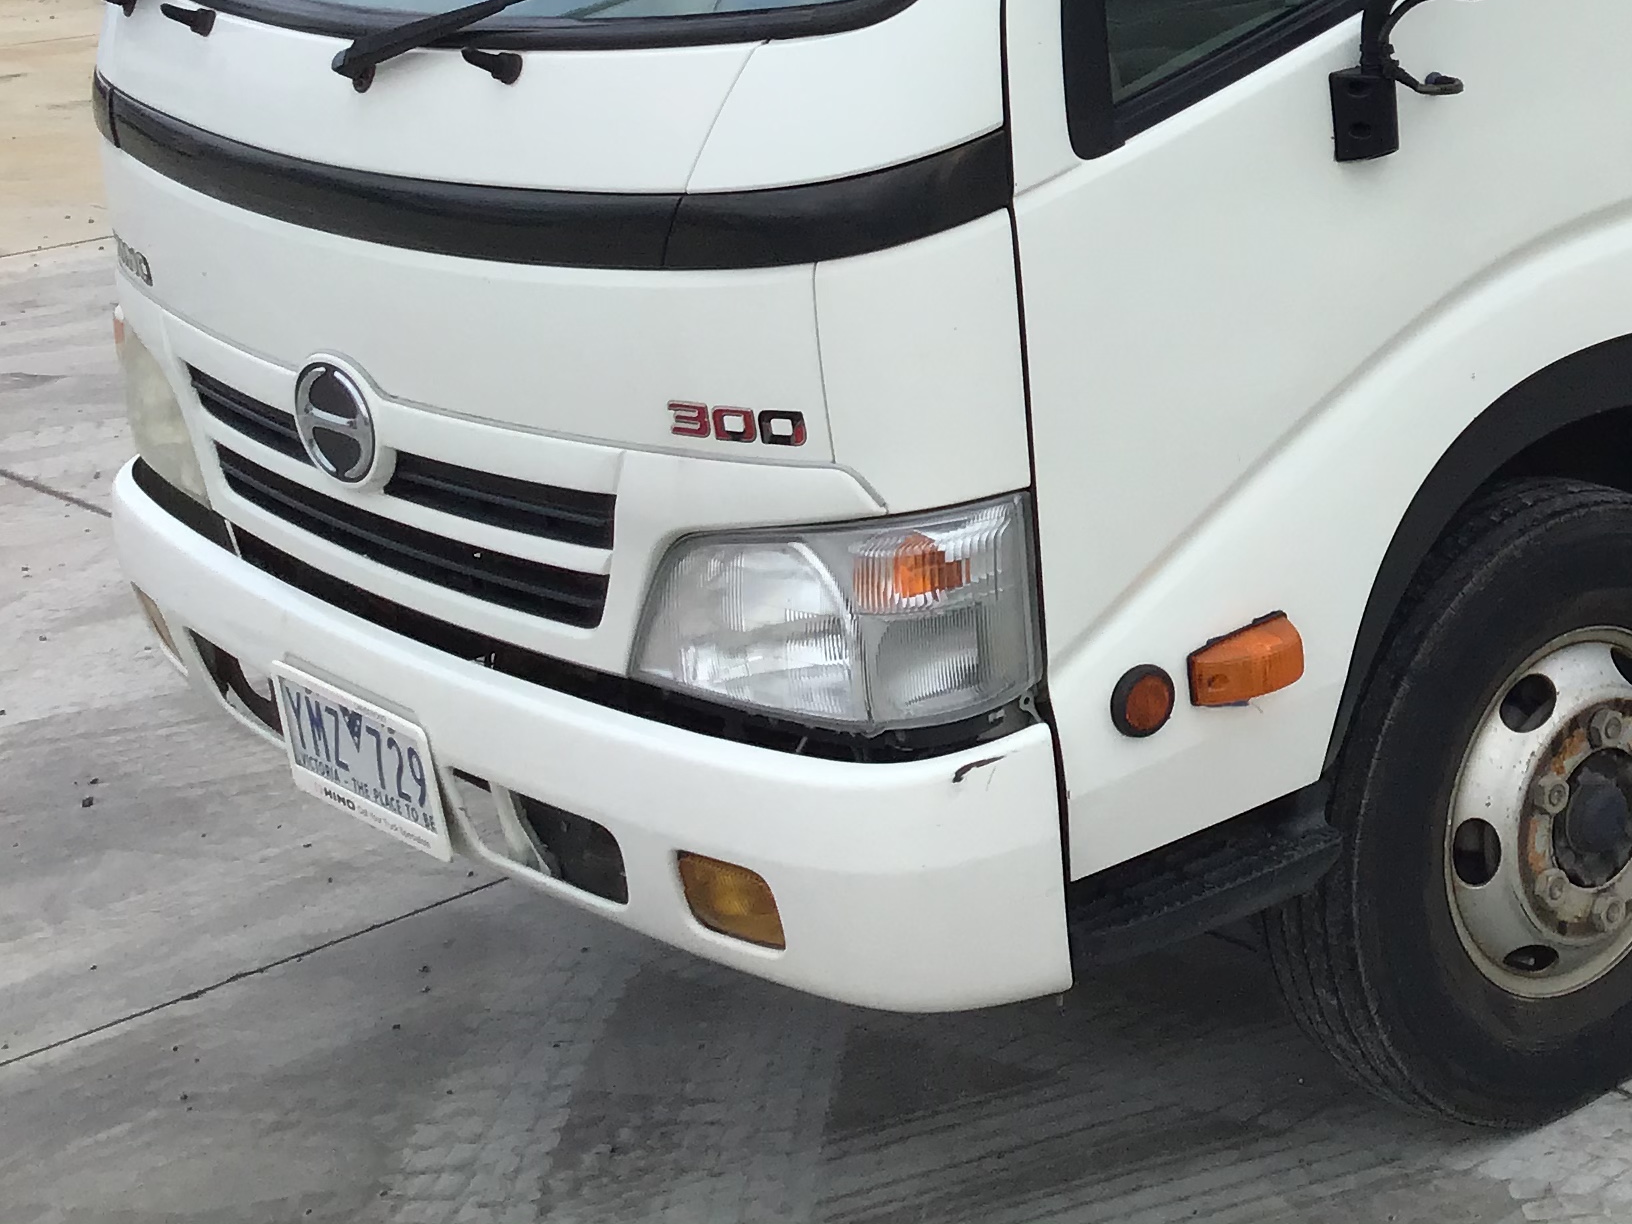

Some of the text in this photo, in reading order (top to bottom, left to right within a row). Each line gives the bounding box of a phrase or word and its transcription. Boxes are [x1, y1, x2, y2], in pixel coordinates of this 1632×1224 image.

[667, 399, 807, 447] 300
[286, 686, 427, 808] YMZ 729
[324, 787, 356, 811] HINO
[351, 777, 371, 799] THE
[372, 788, 402, 816] PLACE
[405, 803, 419, 822] TO
